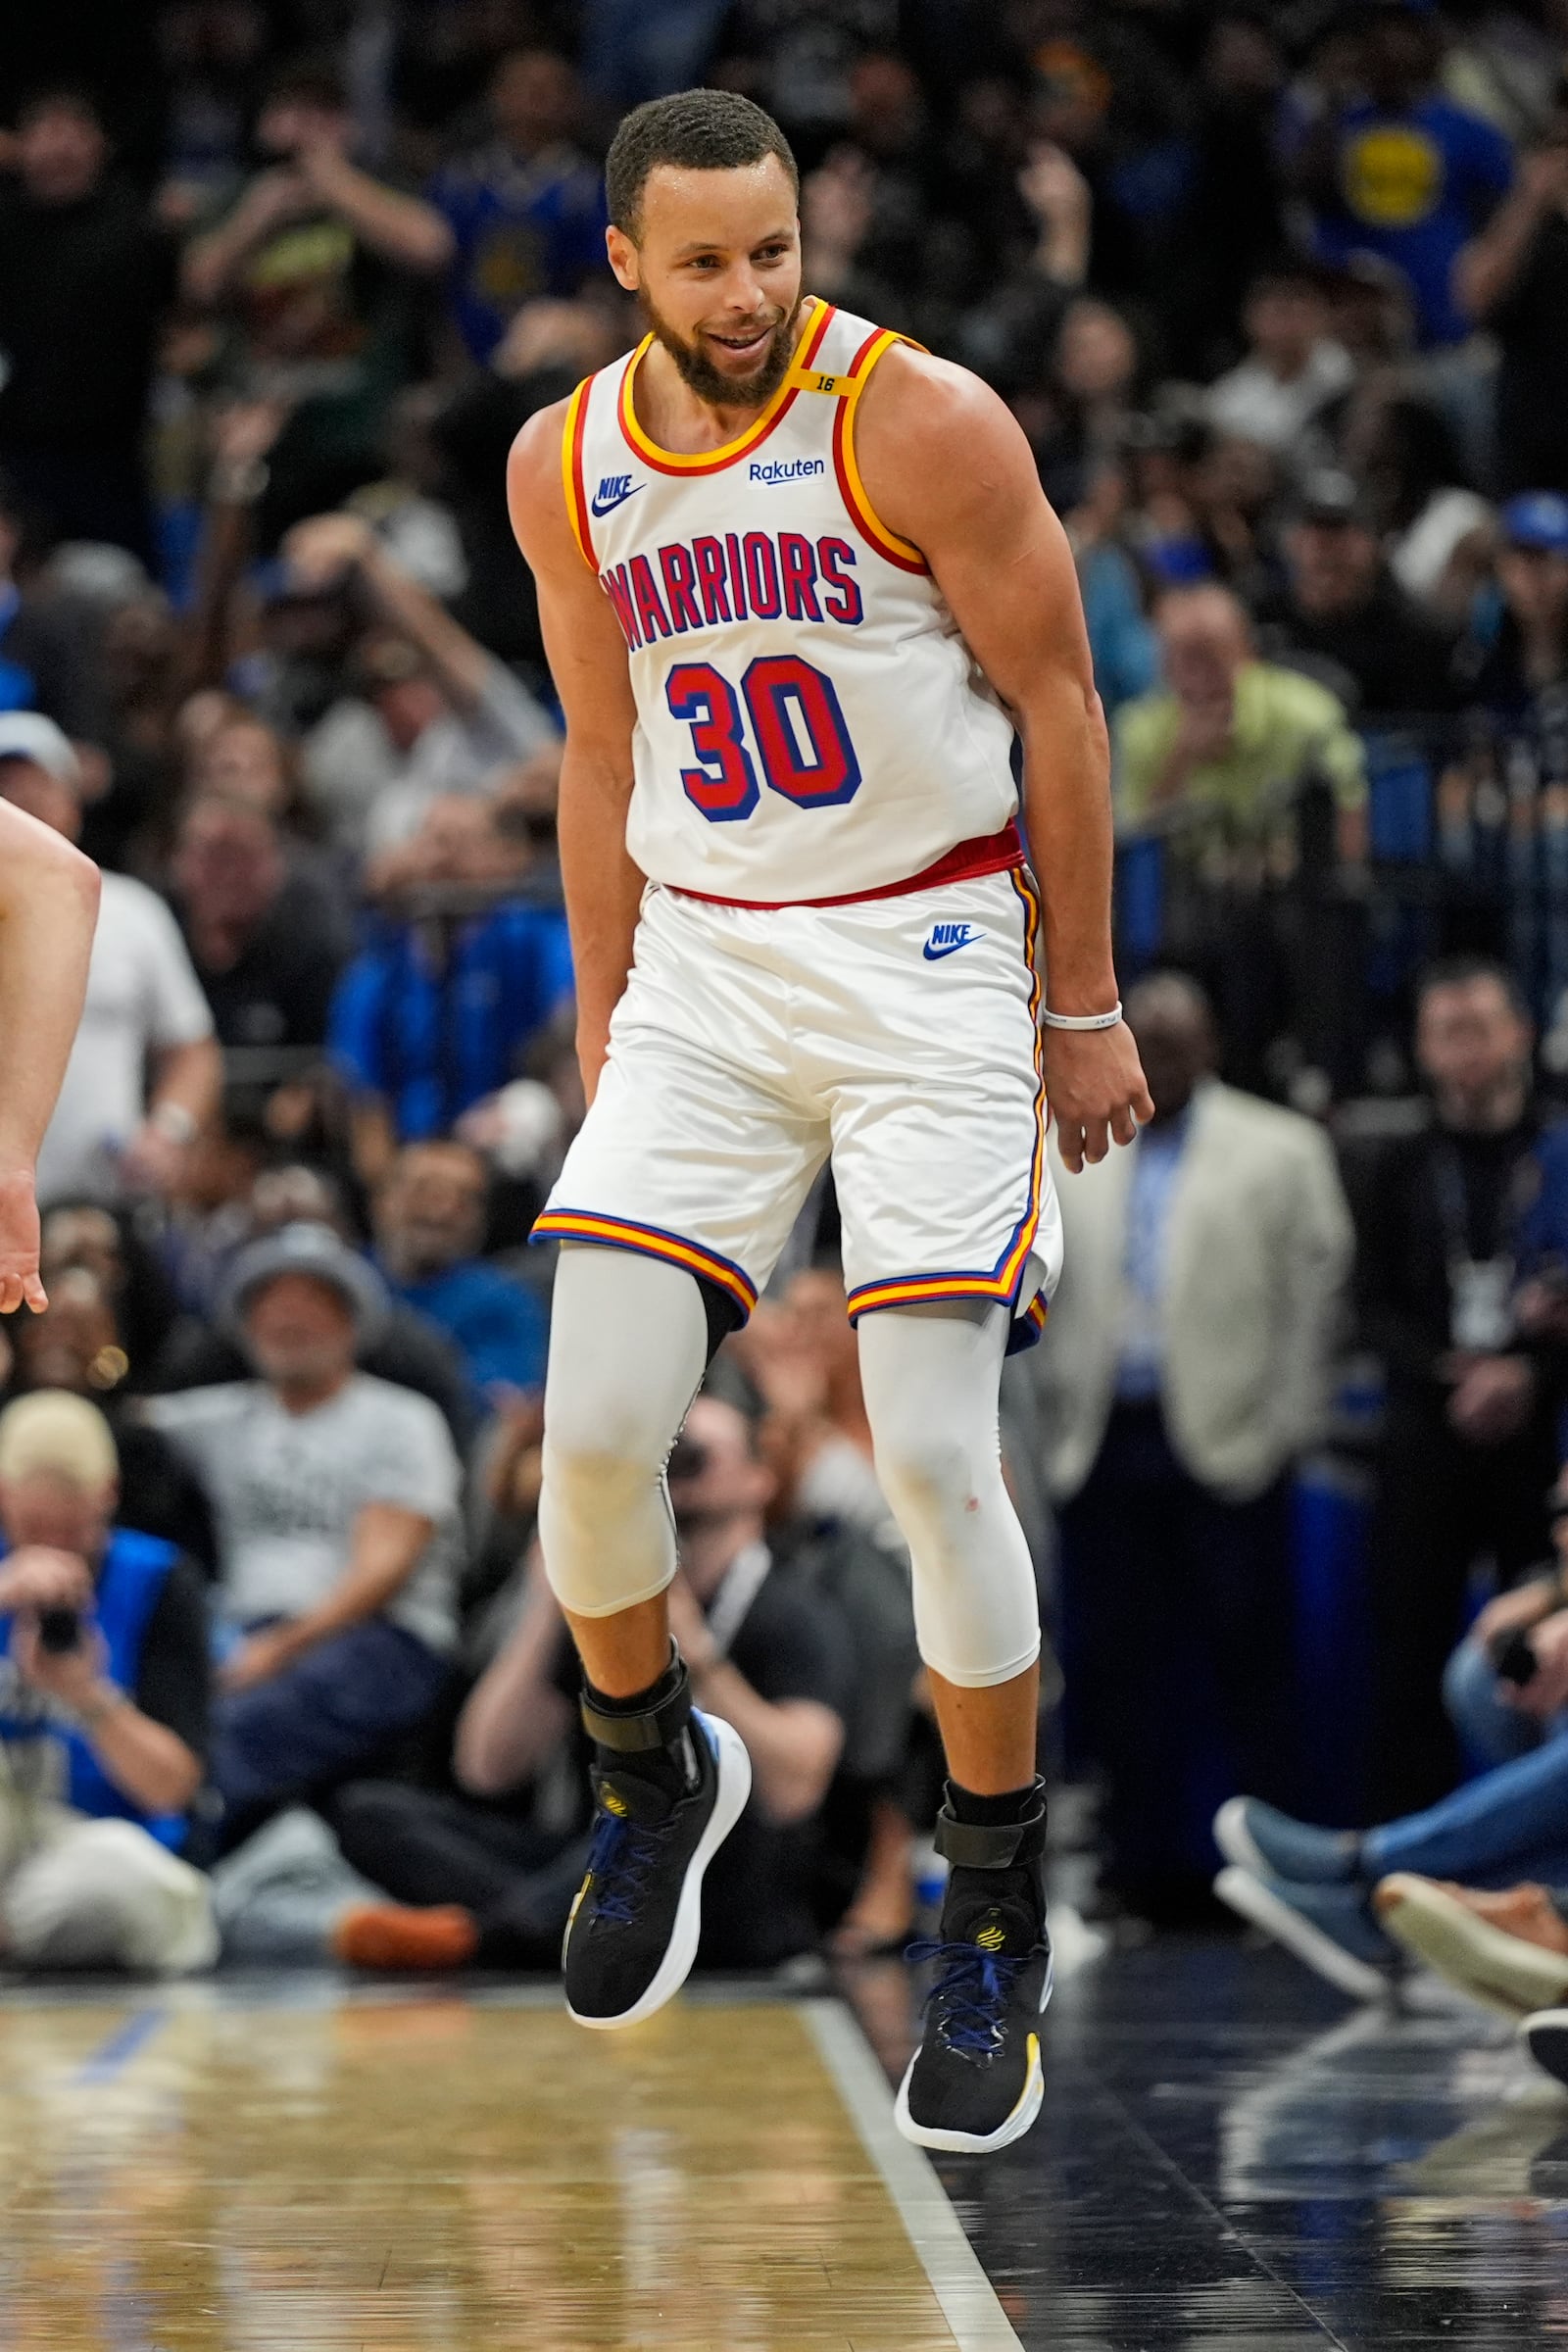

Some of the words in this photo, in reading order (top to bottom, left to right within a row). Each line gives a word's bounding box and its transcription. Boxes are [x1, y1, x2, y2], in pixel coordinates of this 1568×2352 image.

[816, 376, 835, 392] 16
[749, 459, 825, 482] Rakuten
[598, 474, 633, 500] NIKE
[600, 531, 864, 653] WARRIORS
[664, 654, 862, 823] 30
[932, 924, 971, 945] NIKE
